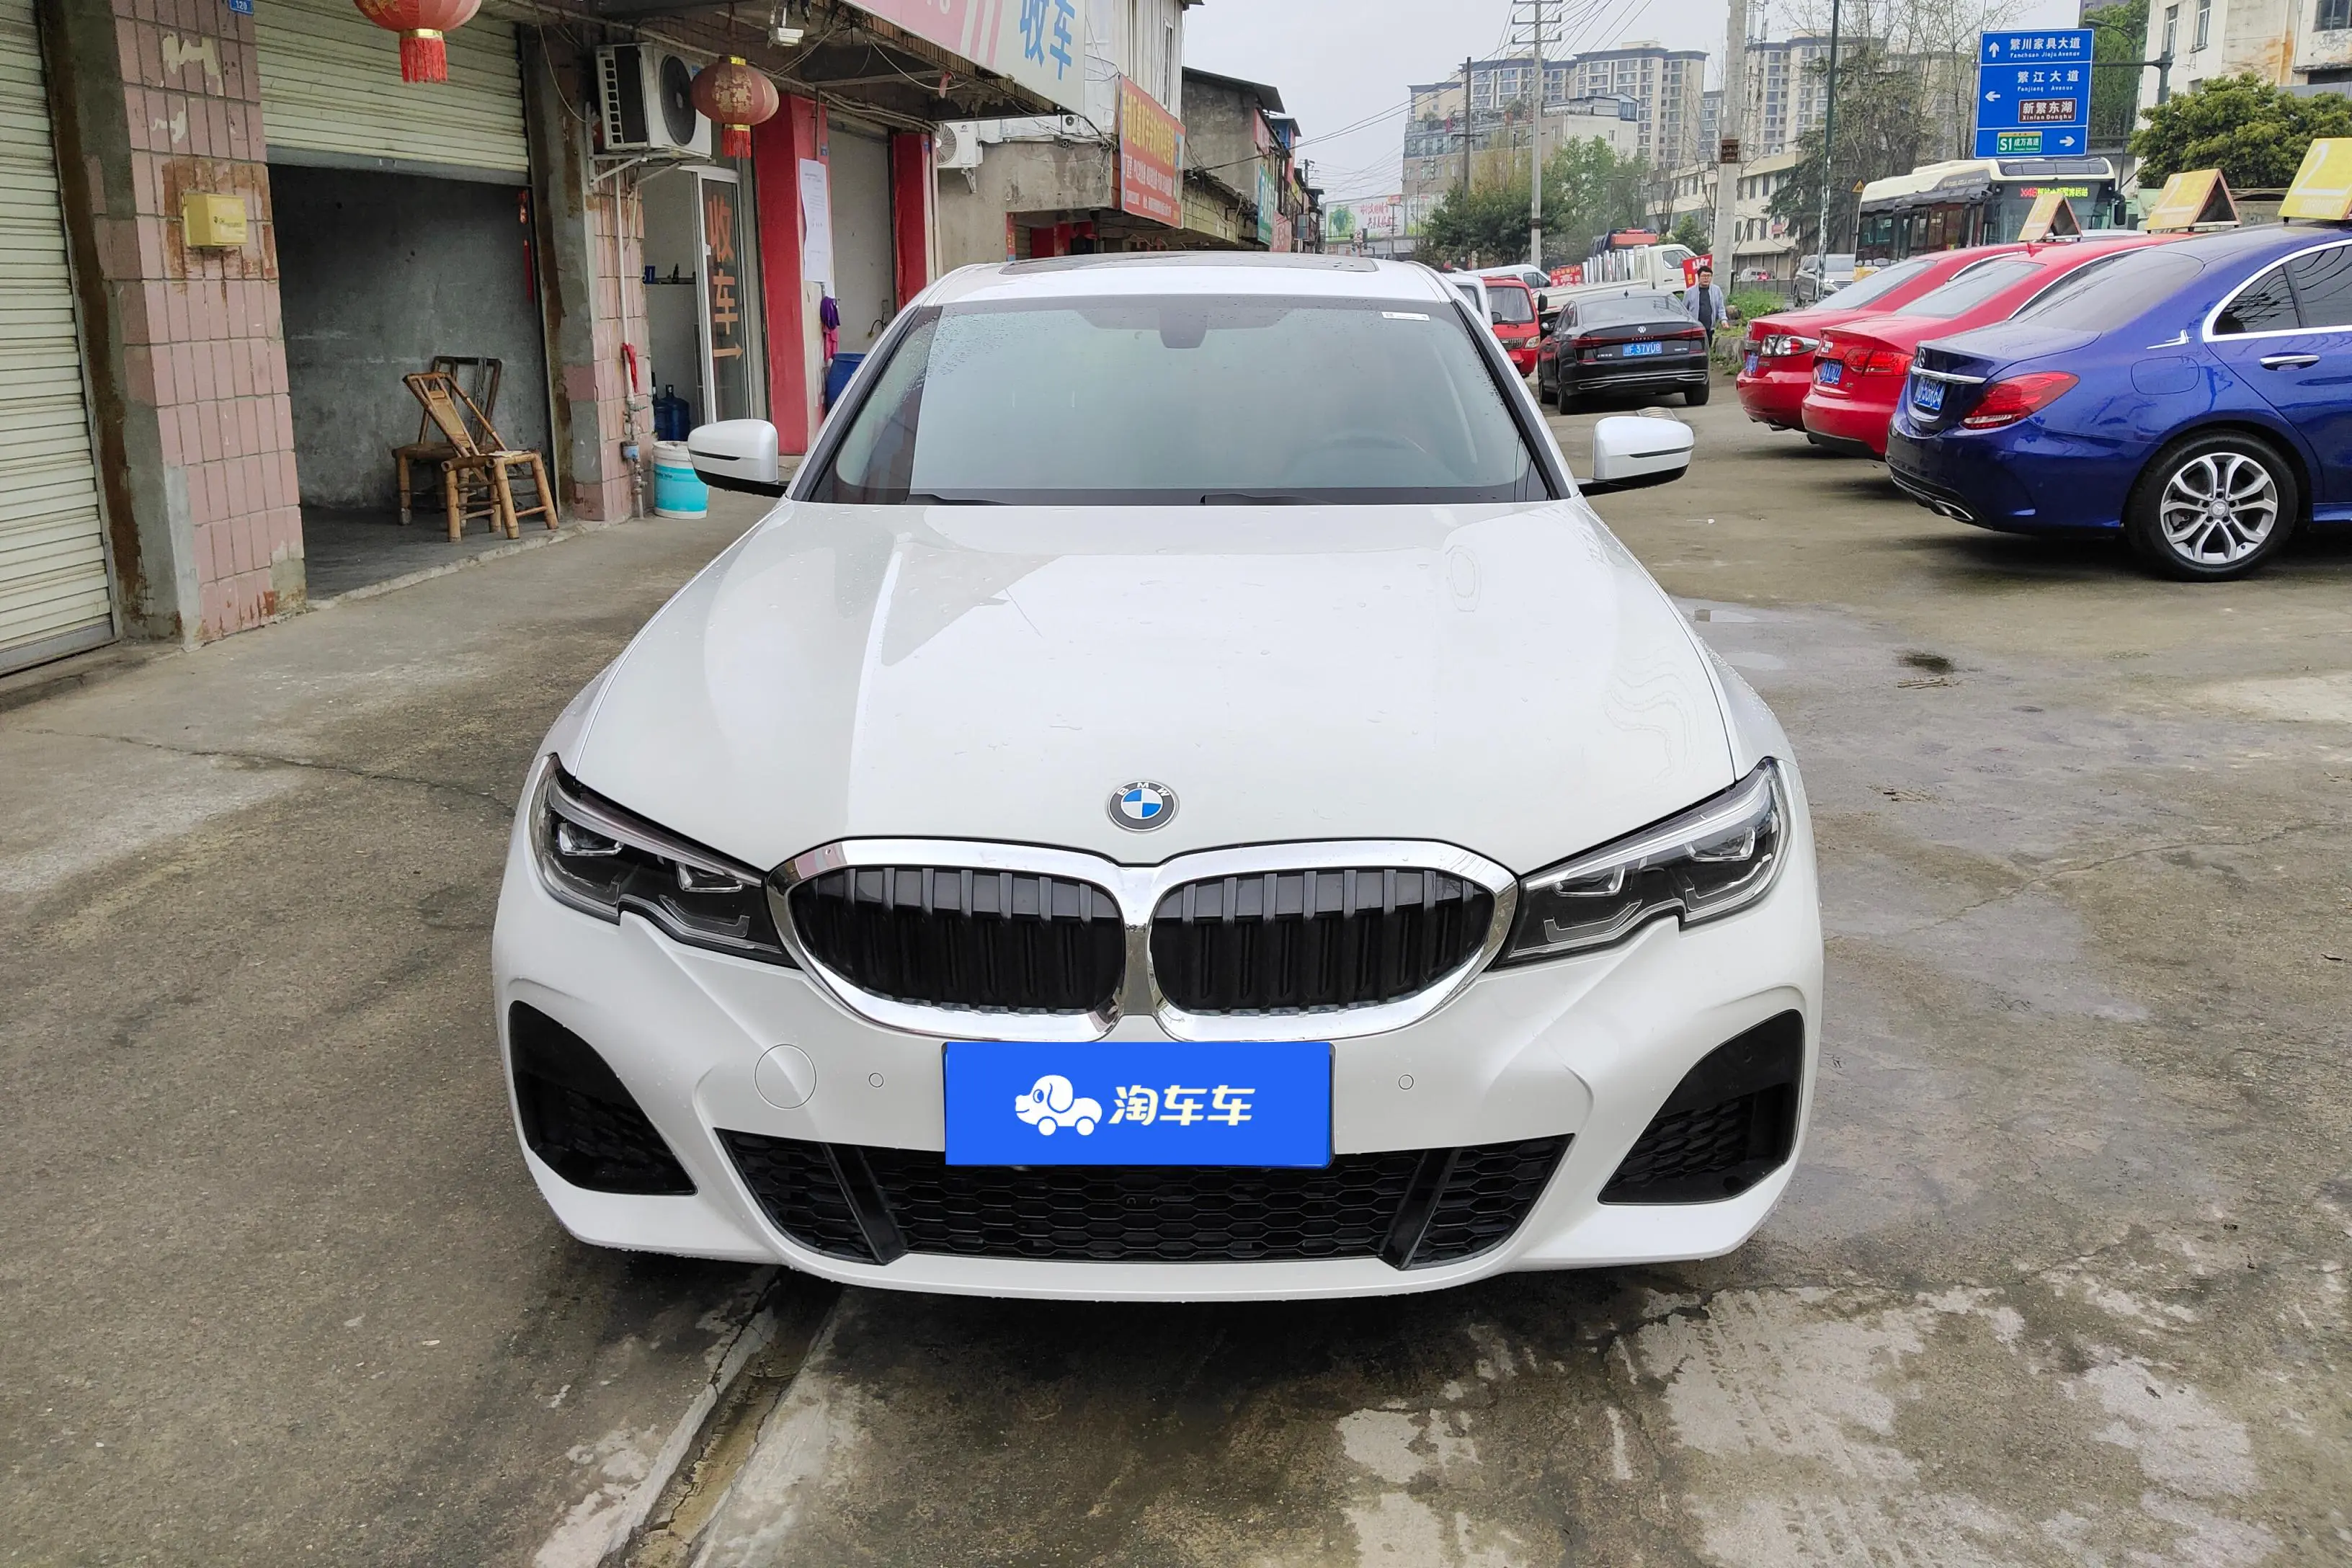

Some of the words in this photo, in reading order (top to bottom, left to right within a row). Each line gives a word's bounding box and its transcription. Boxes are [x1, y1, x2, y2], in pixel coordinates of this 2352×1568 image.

[2010, 37, 2081, 51] 繁川家具大道
[2018, 70, 2080, 84] 繁江大道
[2023, 101, 2073, 115] 新繁东湖
[2000, 138, 2013, 151] S1
[708, 194, 739, 335] 收车
[1117, 782, 1170, 796] BMW
